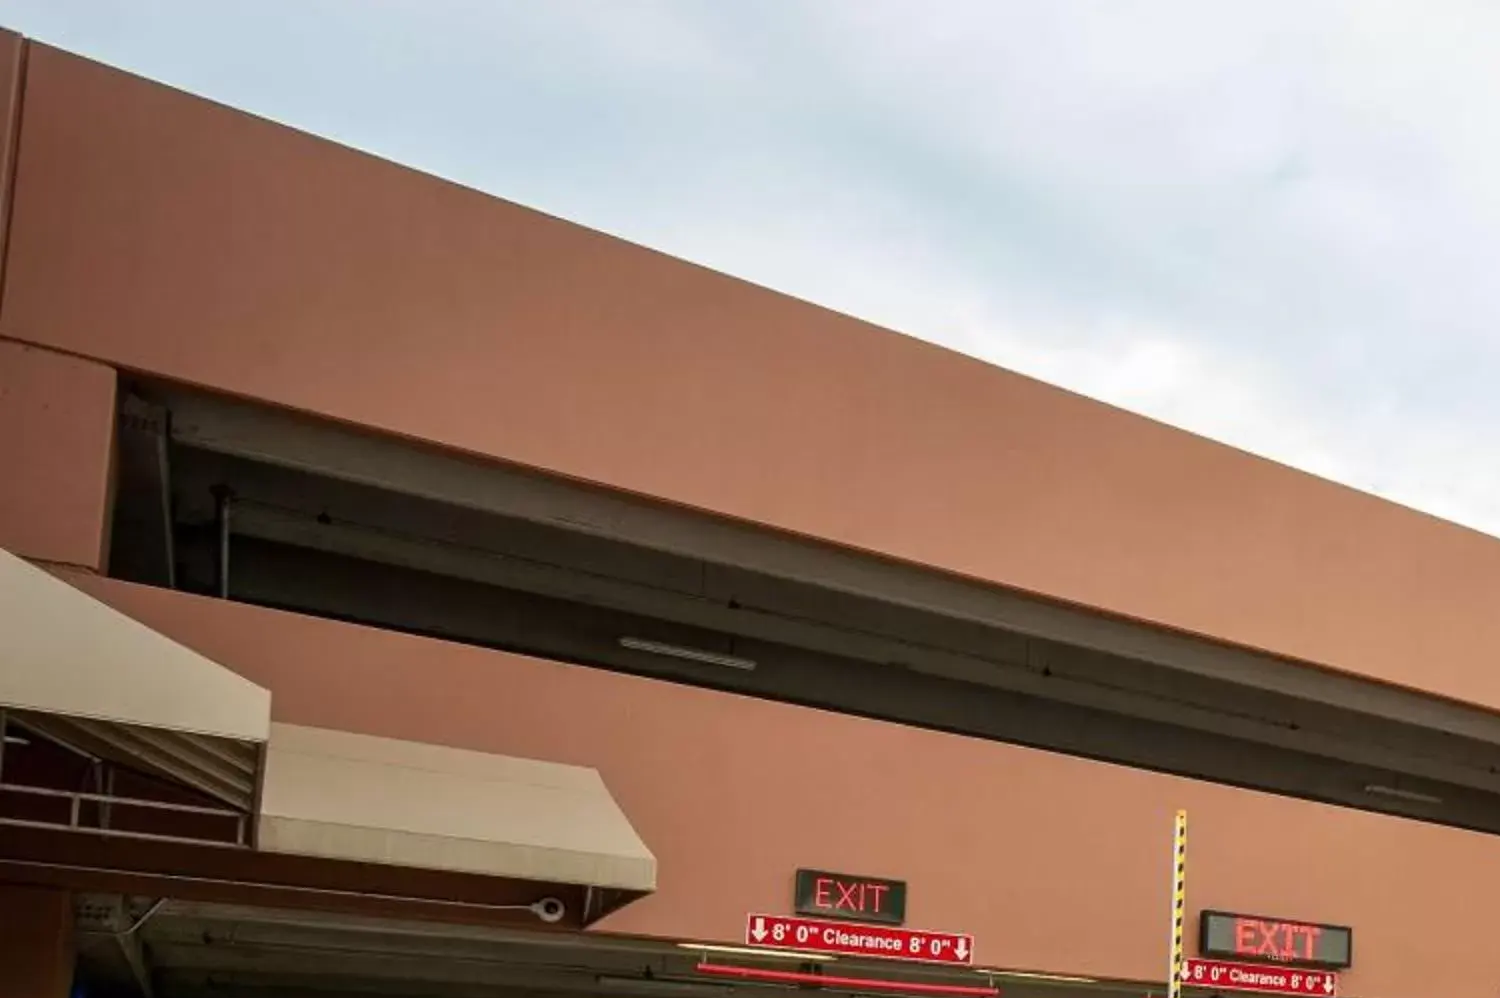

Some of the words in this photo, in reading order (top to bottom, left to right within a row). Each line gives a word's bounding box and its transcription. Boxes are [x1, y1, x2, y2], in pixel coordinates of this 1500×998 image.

[815, 879, 890, 913] EXIT
[823, 928, 903, 950] Clearance
[1234, 918, 1321, 961] EXIT
[1229, 969, 1286, 987] Clearance
